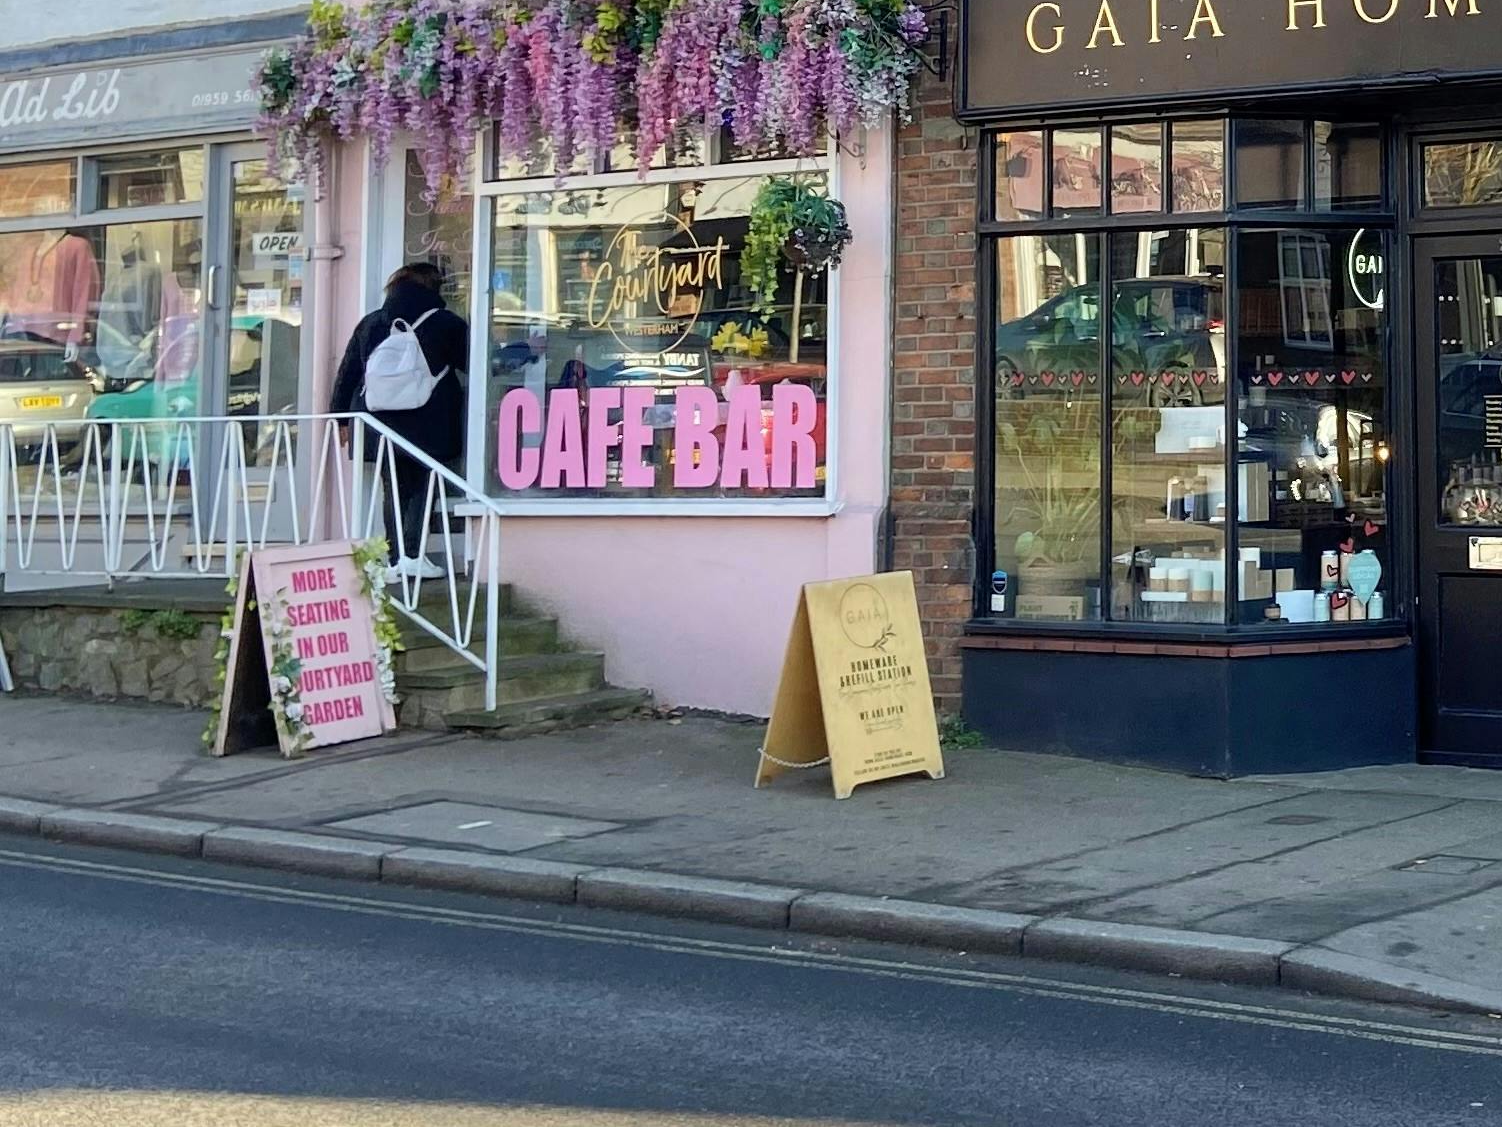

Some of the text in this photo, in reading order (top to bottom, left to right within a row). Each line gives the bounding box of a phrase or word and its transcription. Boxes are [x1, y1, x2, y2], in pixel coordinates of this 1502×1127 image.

[52, 68, 121, 120] Lib
[259, 235, 299, 251] OPEN
[616, 230, 657, 269] The
[588, 236, 730, 329] Courtyard
[497, 384, 817, 490] CAFE BAR
[292, 567, 337, 593] MORE
[287, 598, 351, 627] SEATING
[297, 631, 349, 659] IN OUR
[294, 661, 374, 694] OURTYARD
[303, 695, 364, 726] GARDEN
